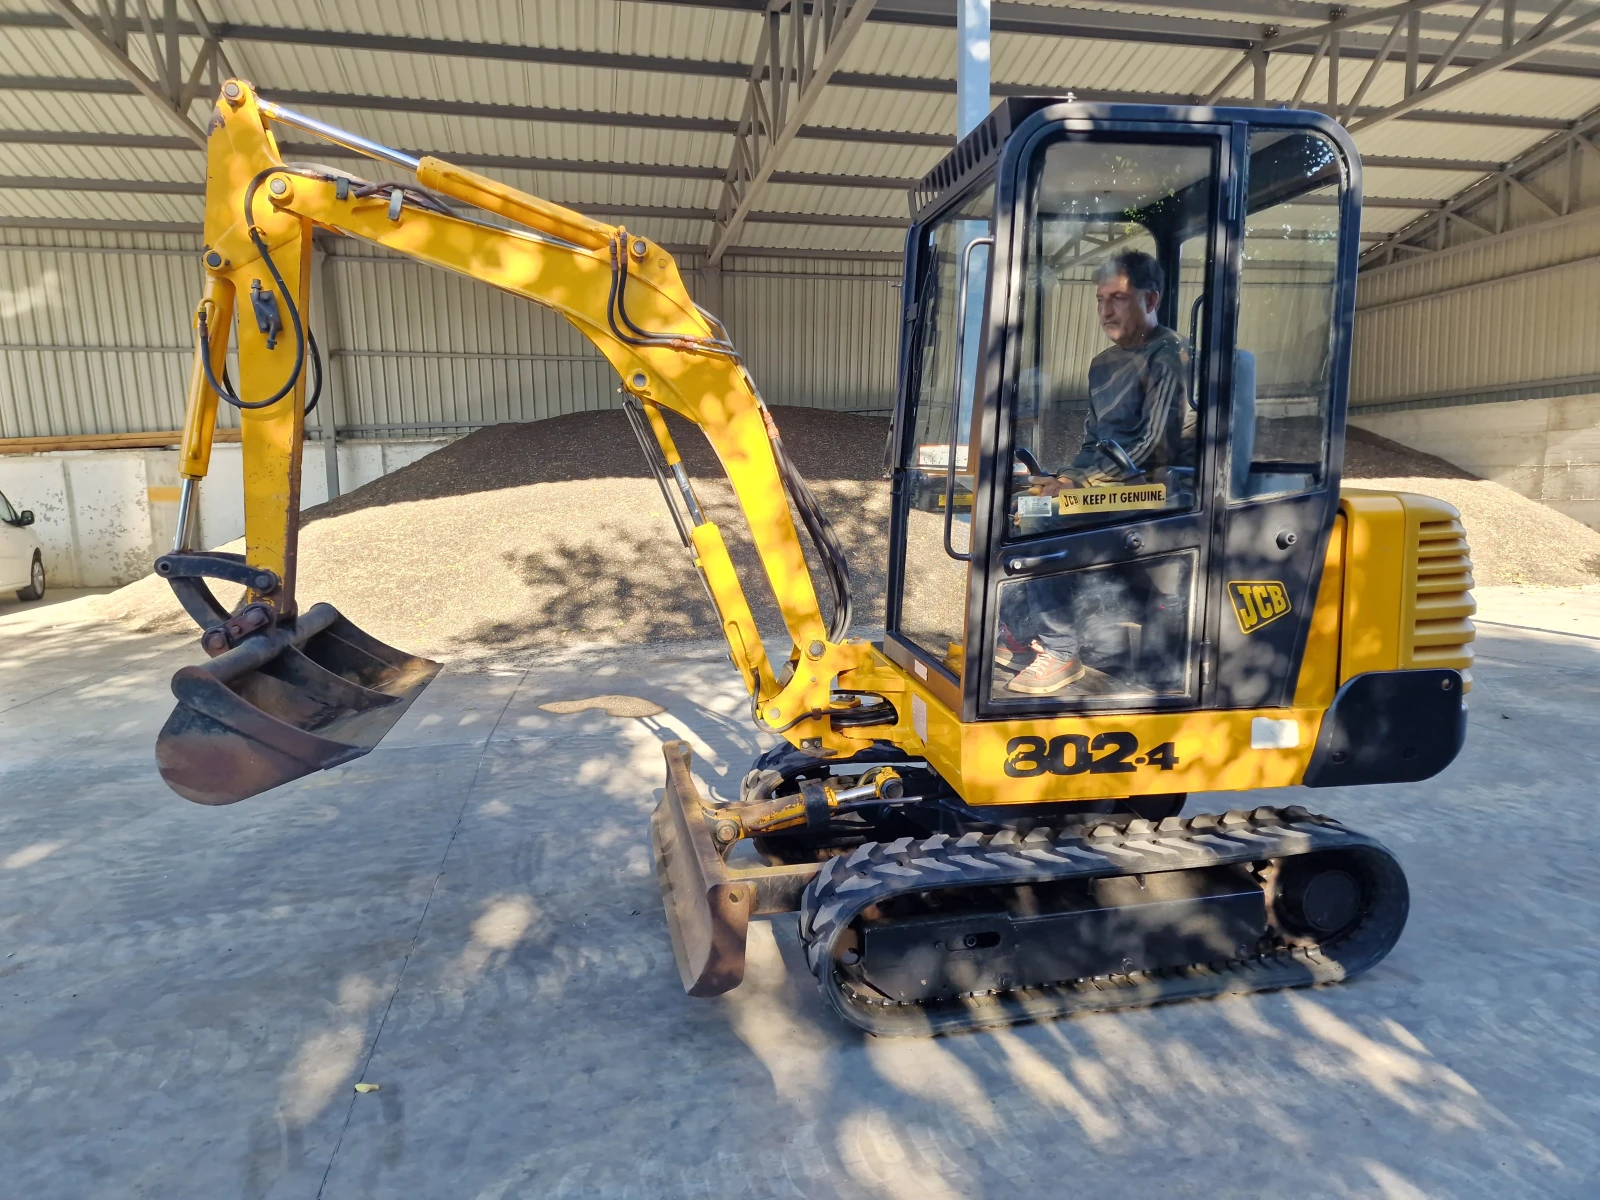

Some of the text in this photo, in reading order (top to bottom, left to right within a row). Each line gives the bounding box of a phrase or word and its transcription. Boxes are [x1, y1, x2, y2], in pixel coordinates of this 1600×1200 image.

[1063, 494, 1079, 507] JCB
[1083, 490, 1165, 505] KEEP IT GENUINE.
[1237, 585, 1287, 628] JCB
[1003, 731, 1180, 778] 802.4
